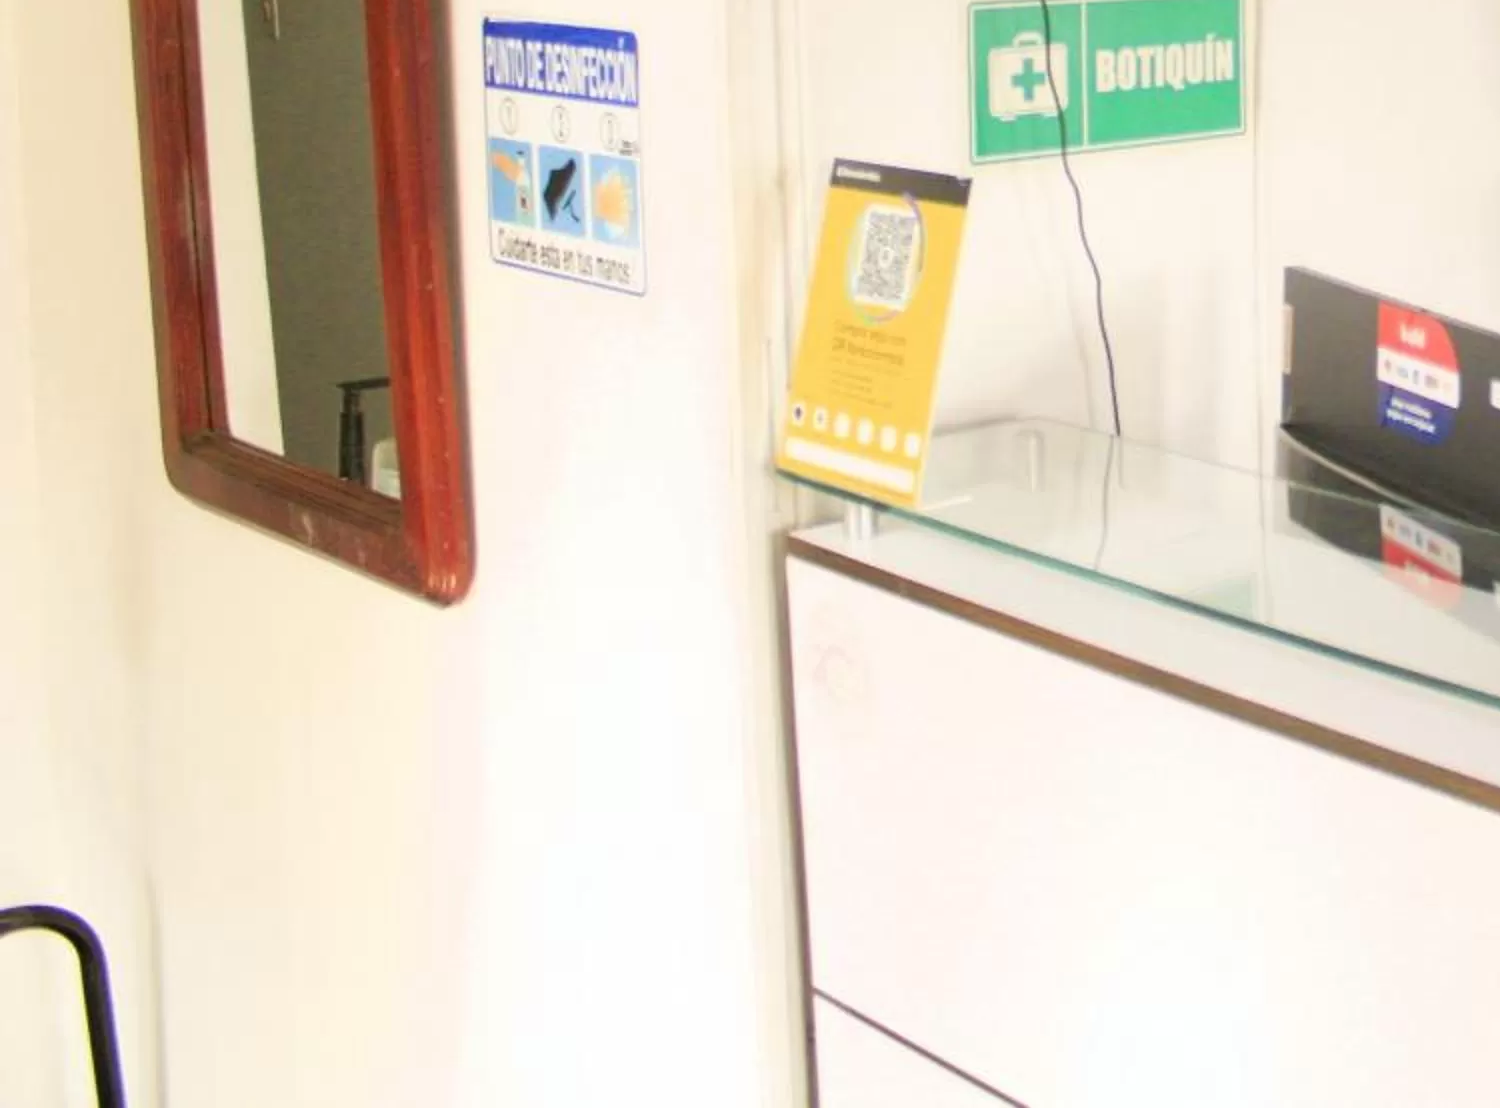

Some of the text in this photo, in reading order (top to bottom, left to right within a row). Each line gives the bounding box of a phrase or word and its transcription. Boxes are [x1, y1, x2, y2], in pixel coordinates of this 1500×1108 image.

[485, 36, 637, 103] PUNTO DE DESINFECCIÓN
[1095, 32, 1235, 93] BOTIQUÍN
